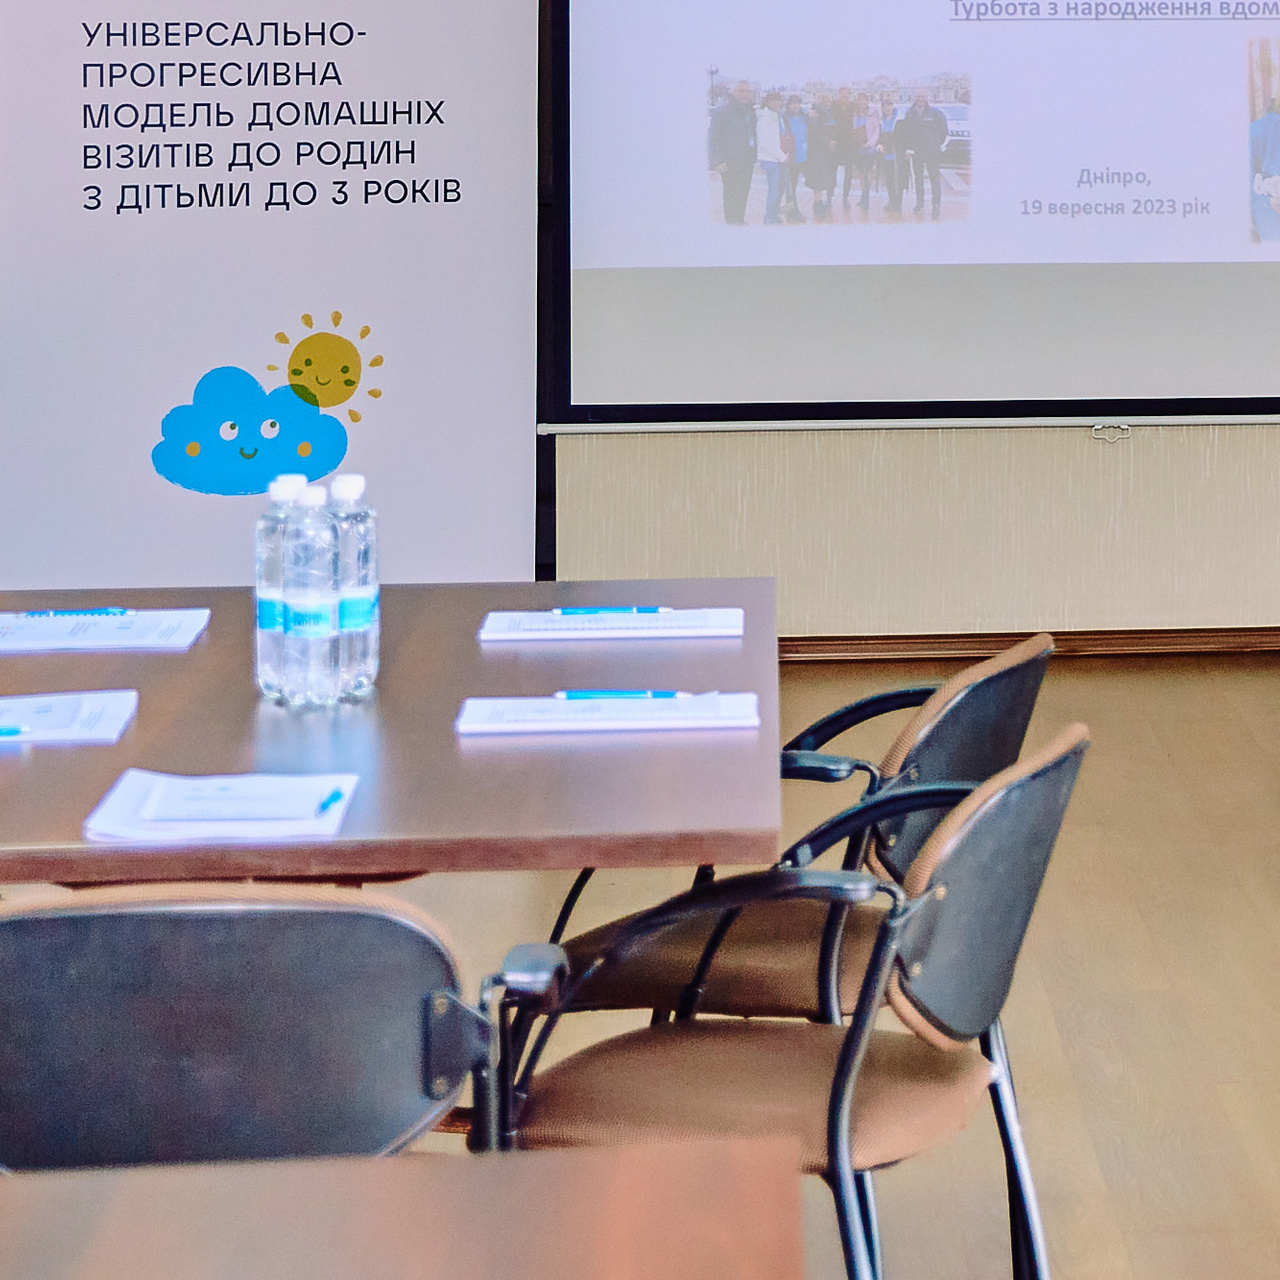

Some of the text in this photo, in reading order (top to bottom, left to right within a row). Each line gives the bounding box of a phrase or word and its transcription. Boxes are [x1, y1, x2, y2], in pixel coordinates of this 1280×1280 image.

[1047, 1, 1058, 16] з
[1065, 0, 1213, 20] народження
[81, 21, 367, 48] УНІВЕРСАЛЬНО-
[81, 61, 343, 89] ПРОГРЕСИВНА
[81, 99, 446, 134] МОДЕЛЬ ДОМАШНІХ
[82, 139, 416, 172] ВІЗИТІВ ДО РОДИН
[1077, 167, 1152, 188] Дніпро,
[82, 178, 462, 215] З ДІТЬМИ ДО 3 РОКІВ
[1020, 196, 1210, 218] 19 вересня 2023 рік
